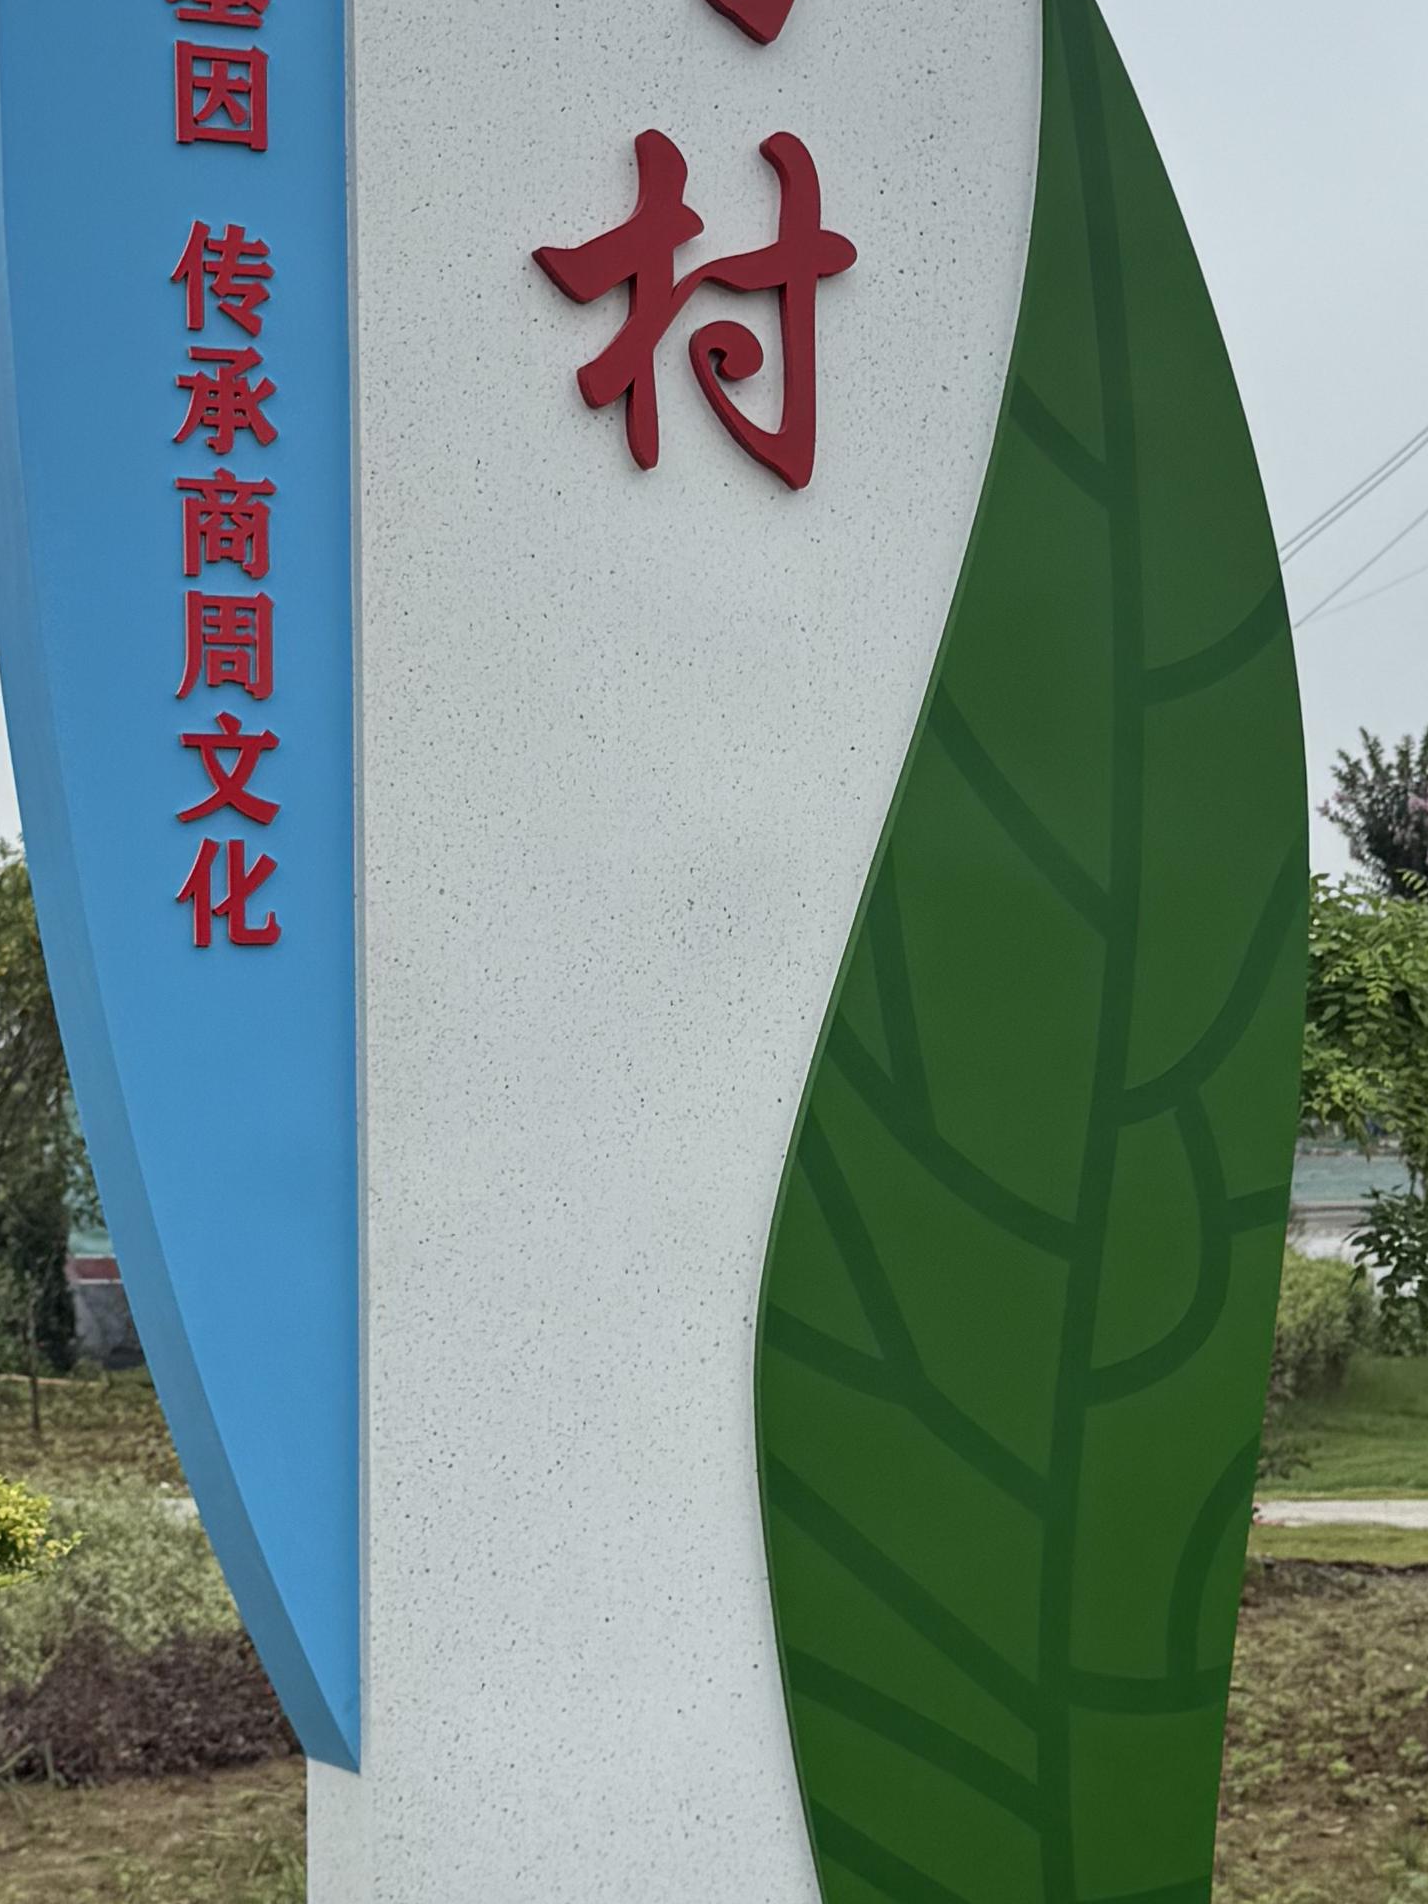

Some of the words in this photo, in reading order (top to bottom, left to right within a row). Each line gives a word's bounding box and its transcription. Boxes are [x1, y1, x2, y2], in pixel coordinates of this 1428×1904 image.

[169, 220, 281, 949] 传承商周文化
